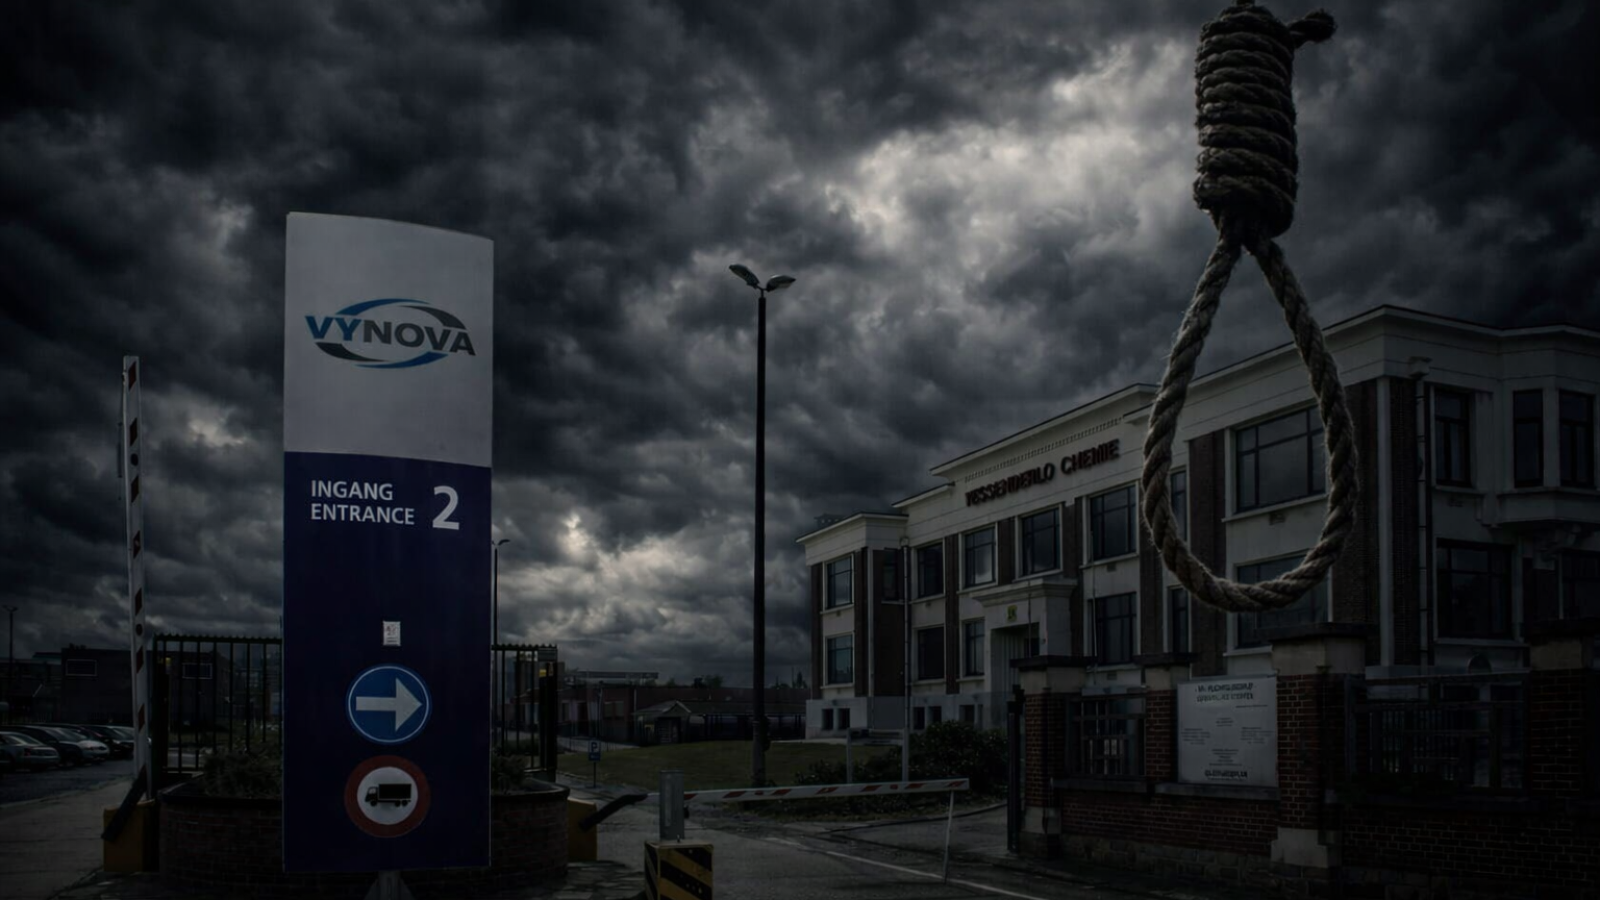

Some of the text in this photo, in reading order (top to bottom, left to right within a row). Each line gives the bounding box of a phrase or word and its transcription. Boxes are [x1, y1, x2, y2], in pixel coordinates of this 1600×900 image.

[305, 315, 476, 356] VYNOVA
[310, 479, 394, 501] INGANG
[310, 502, 415, 525] ENTRANCE
[431, 485, 460, 531] 2
